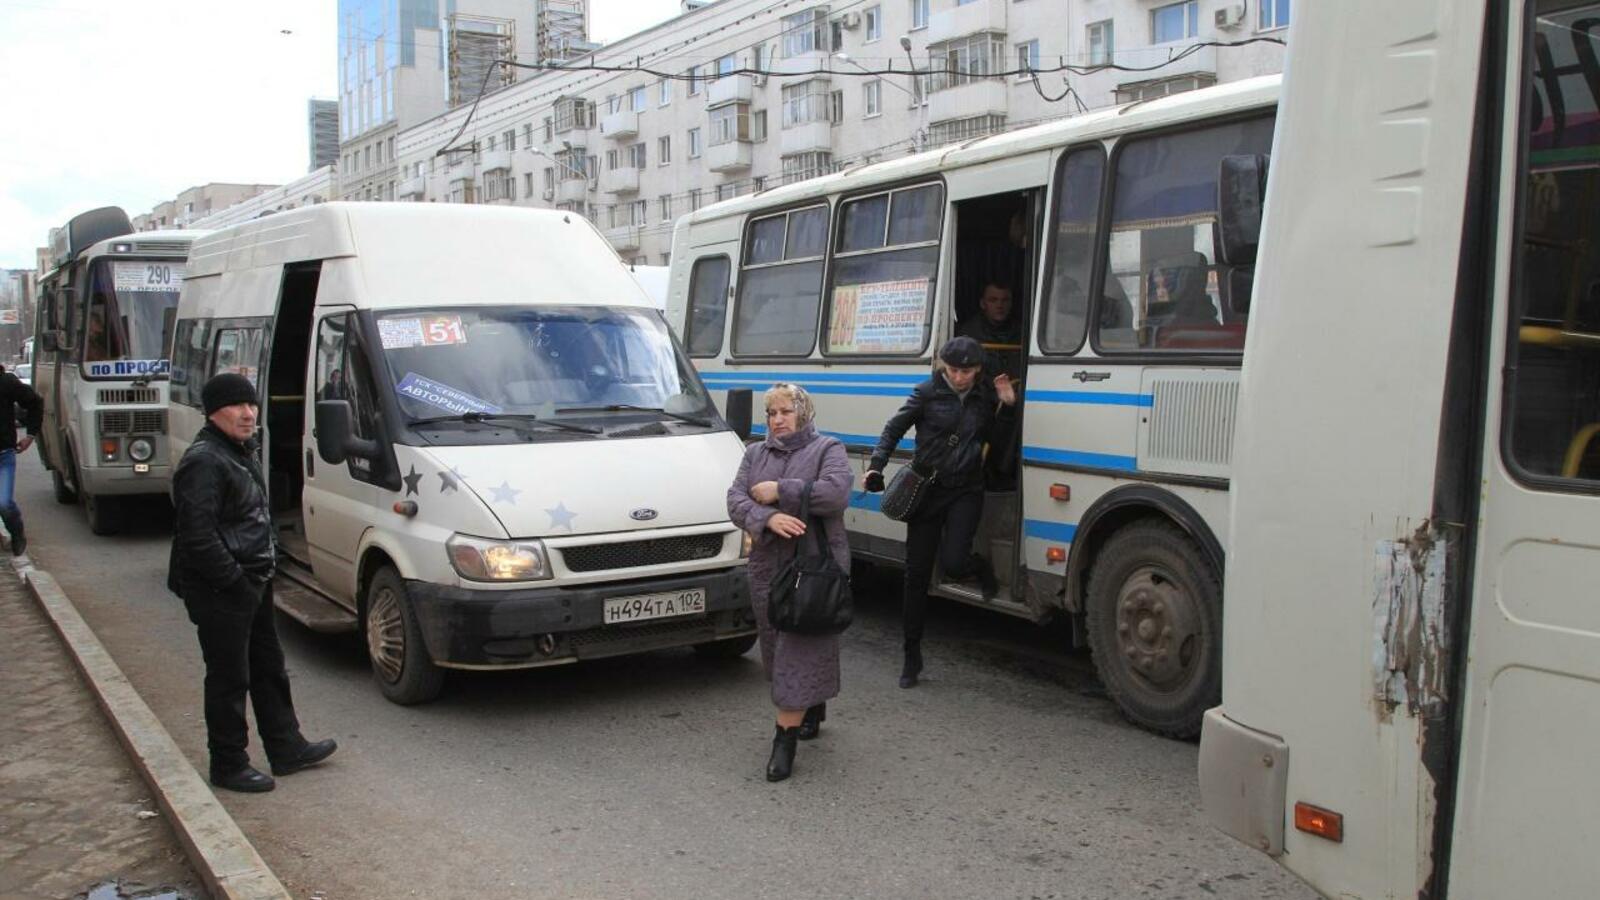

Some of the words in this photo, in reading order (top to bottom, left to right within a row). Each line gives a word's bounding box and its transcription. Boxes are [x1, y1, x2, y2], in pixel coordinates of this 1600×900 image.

[147, 265, 170, 285] 290
[429, 322, 462, 342] 51
[679, 592, 701, 606] 102
